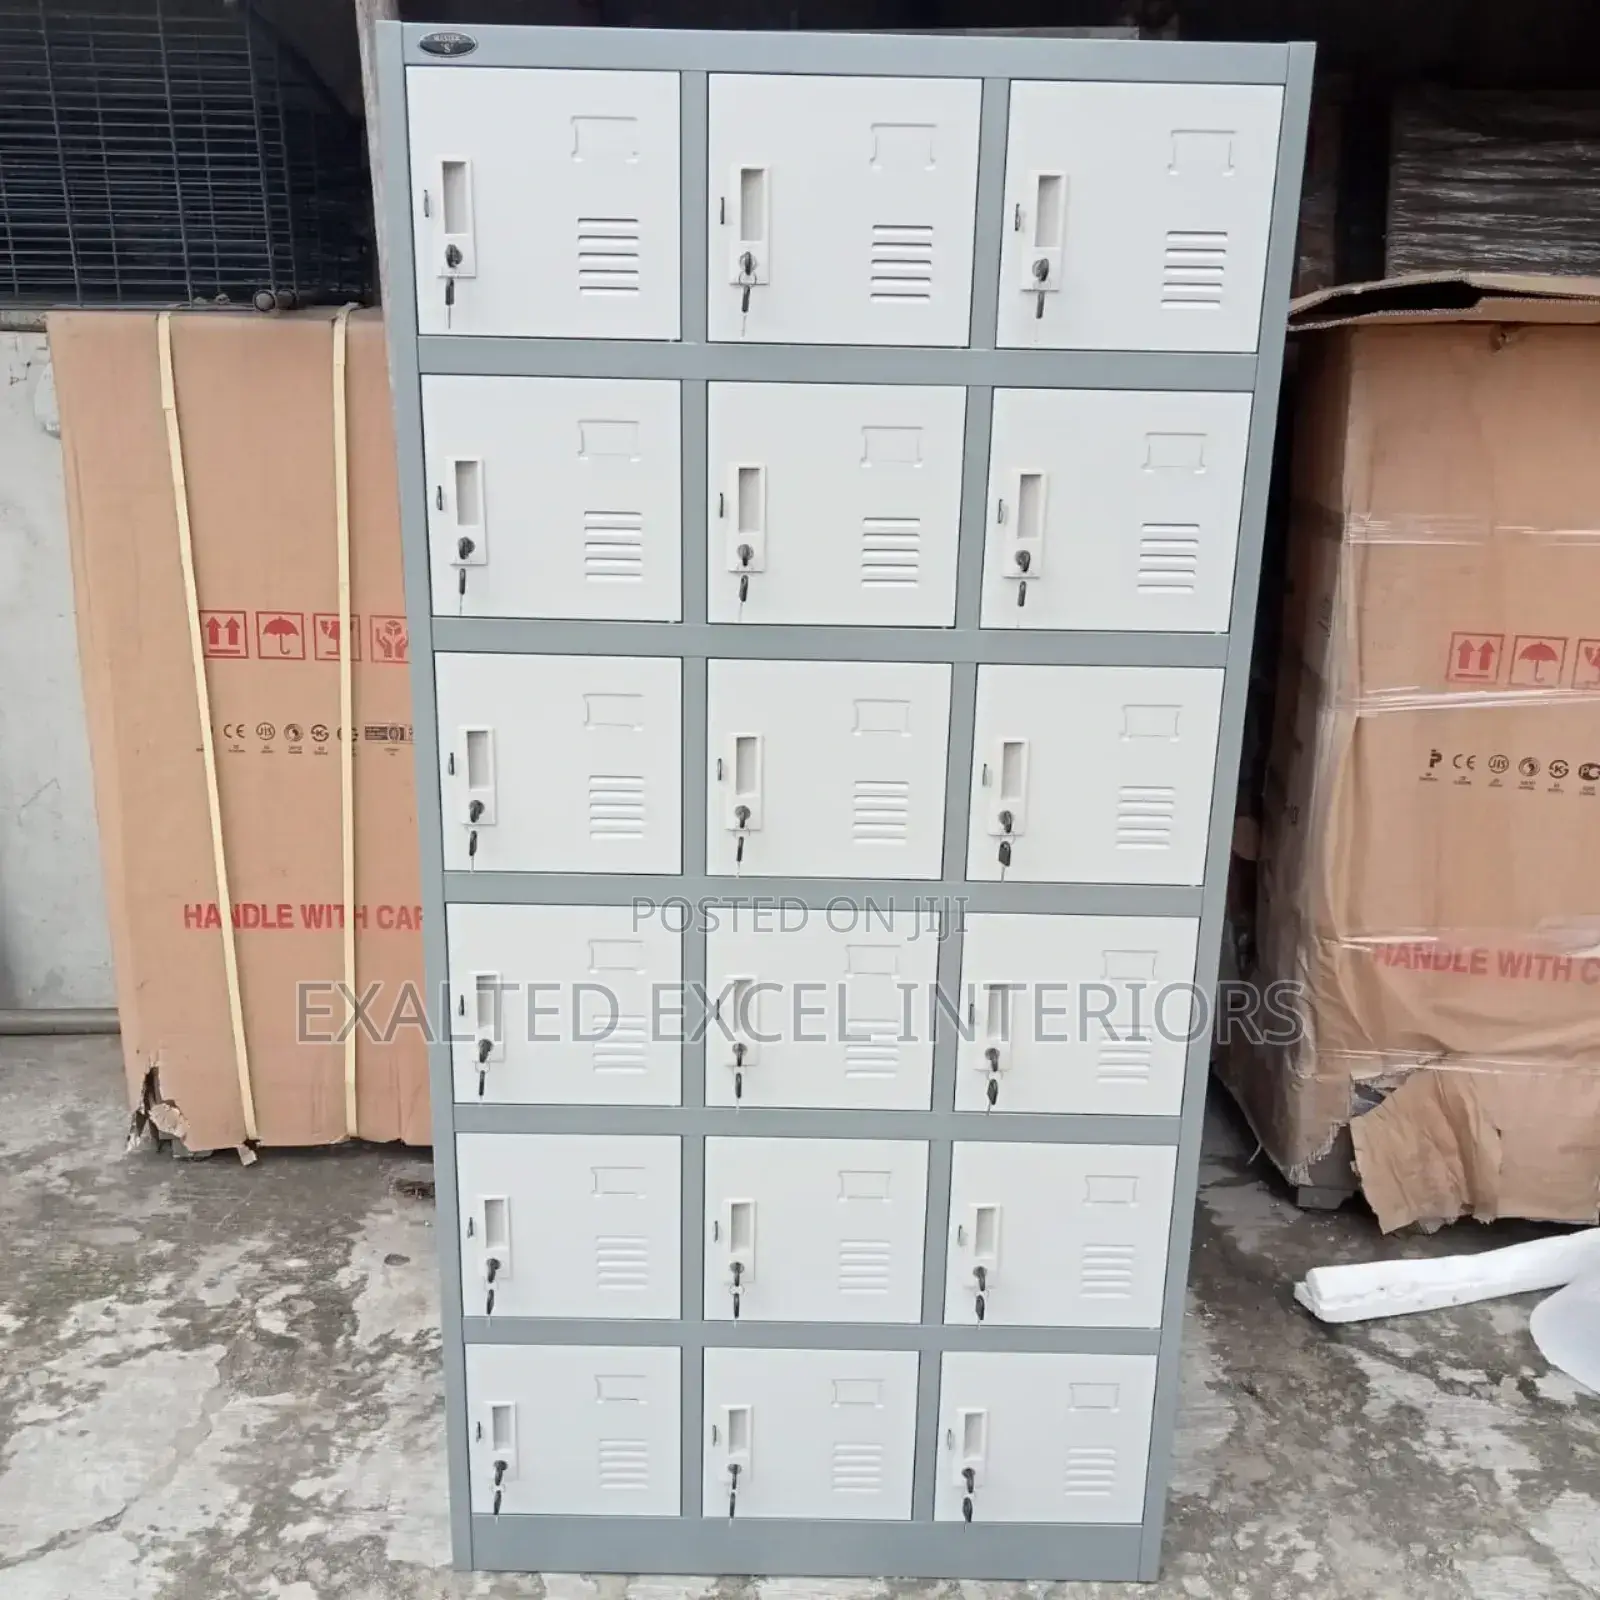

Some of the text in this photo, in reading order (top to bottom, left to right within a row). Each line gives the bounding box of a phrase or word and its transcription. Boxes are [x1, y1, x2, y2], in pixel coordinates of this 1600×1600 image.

[183, 903, 294, 929] HANDLE
[1373, 942, 1489, 976] HANDLE
[1497, 950, 1573, 982] WITH
